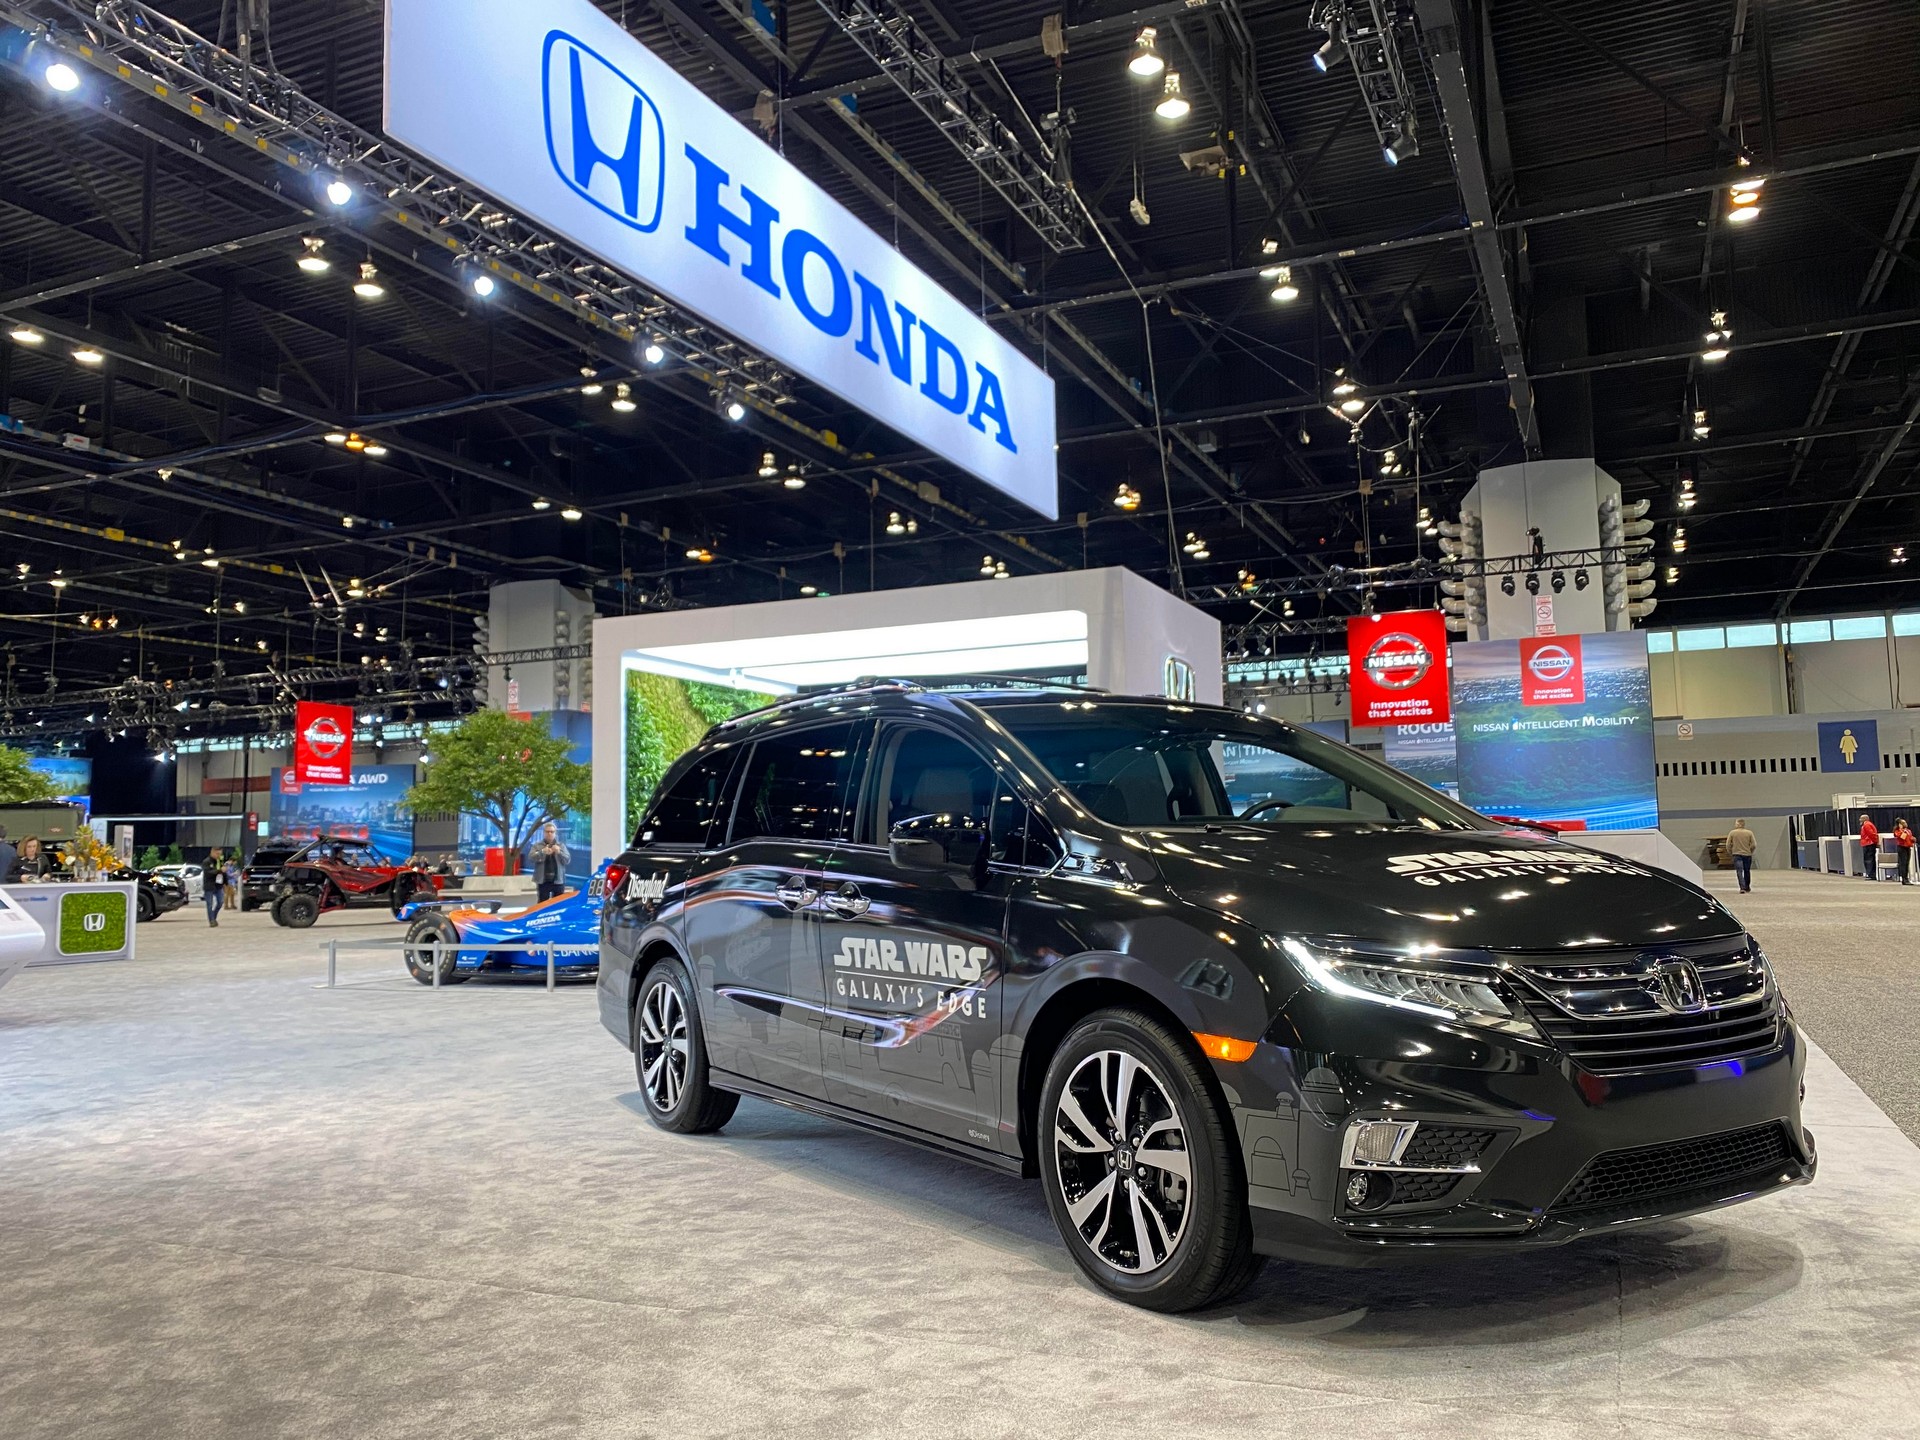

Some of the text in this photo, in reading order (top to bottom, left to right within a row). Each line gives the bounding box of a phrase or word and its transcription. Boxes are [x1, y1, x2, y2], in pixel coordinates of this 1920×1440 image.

[685, 142, 1018, 455] HONDA
[1368, 654, 1426, 668] NISSAN
[1532, 659, 1571, 667] NISSAN
[1370, 698, 1429, 710] Innovation
[1368, 707, 1434, 719] that excites
[1397, 722, 1454, 736] ROGUE
[1473, 722, 1509, 732] NISSAN
[358, 773, 389, 784] AWD
[1385, 851, 1501, 873] STAR
[1413, 865, 1569, 886] GALAXY'S
[625, 872, 669, 904] Disneyland
[525, 915, 562, 927] HONDA
[833, 937, 987, 982] STAR WARS
[836, 977, 986, 1019] GALAXY'S EDGE
